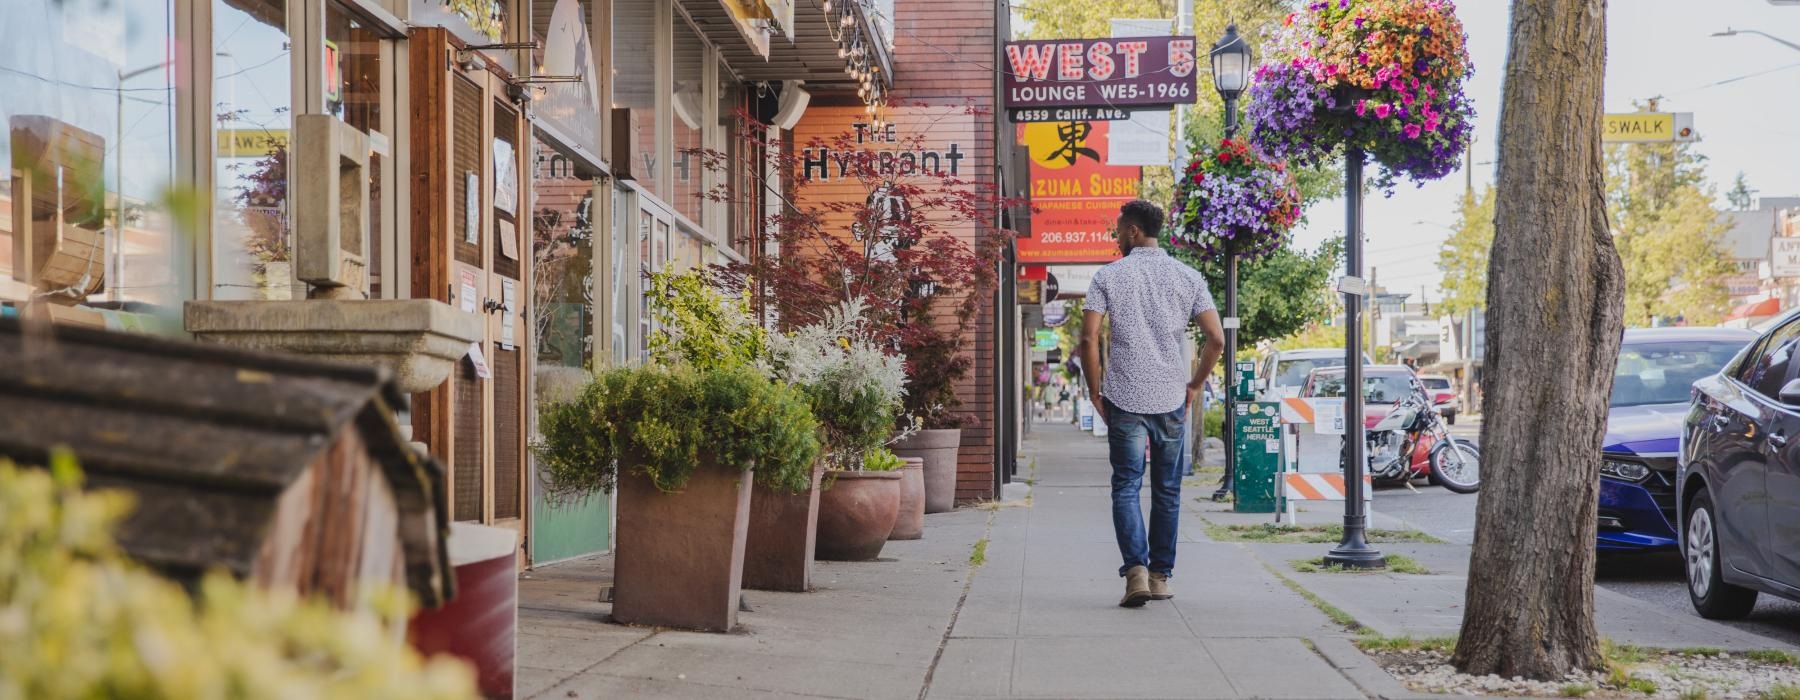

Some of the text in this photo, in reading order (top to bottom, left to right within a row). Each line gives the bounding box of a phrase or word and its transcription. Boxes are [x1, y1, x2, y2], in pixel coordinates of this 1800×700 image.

[1006, 40, 1194, 82] WEST 5
[1012, 83, 1189, 101] LOUNGE WE5-1966
[1016, 108, 1126, 121] 4539 Calif. Ave.
[853, 123, 896, 143] THE
[1602, 120, 1663, 134] SWALK
